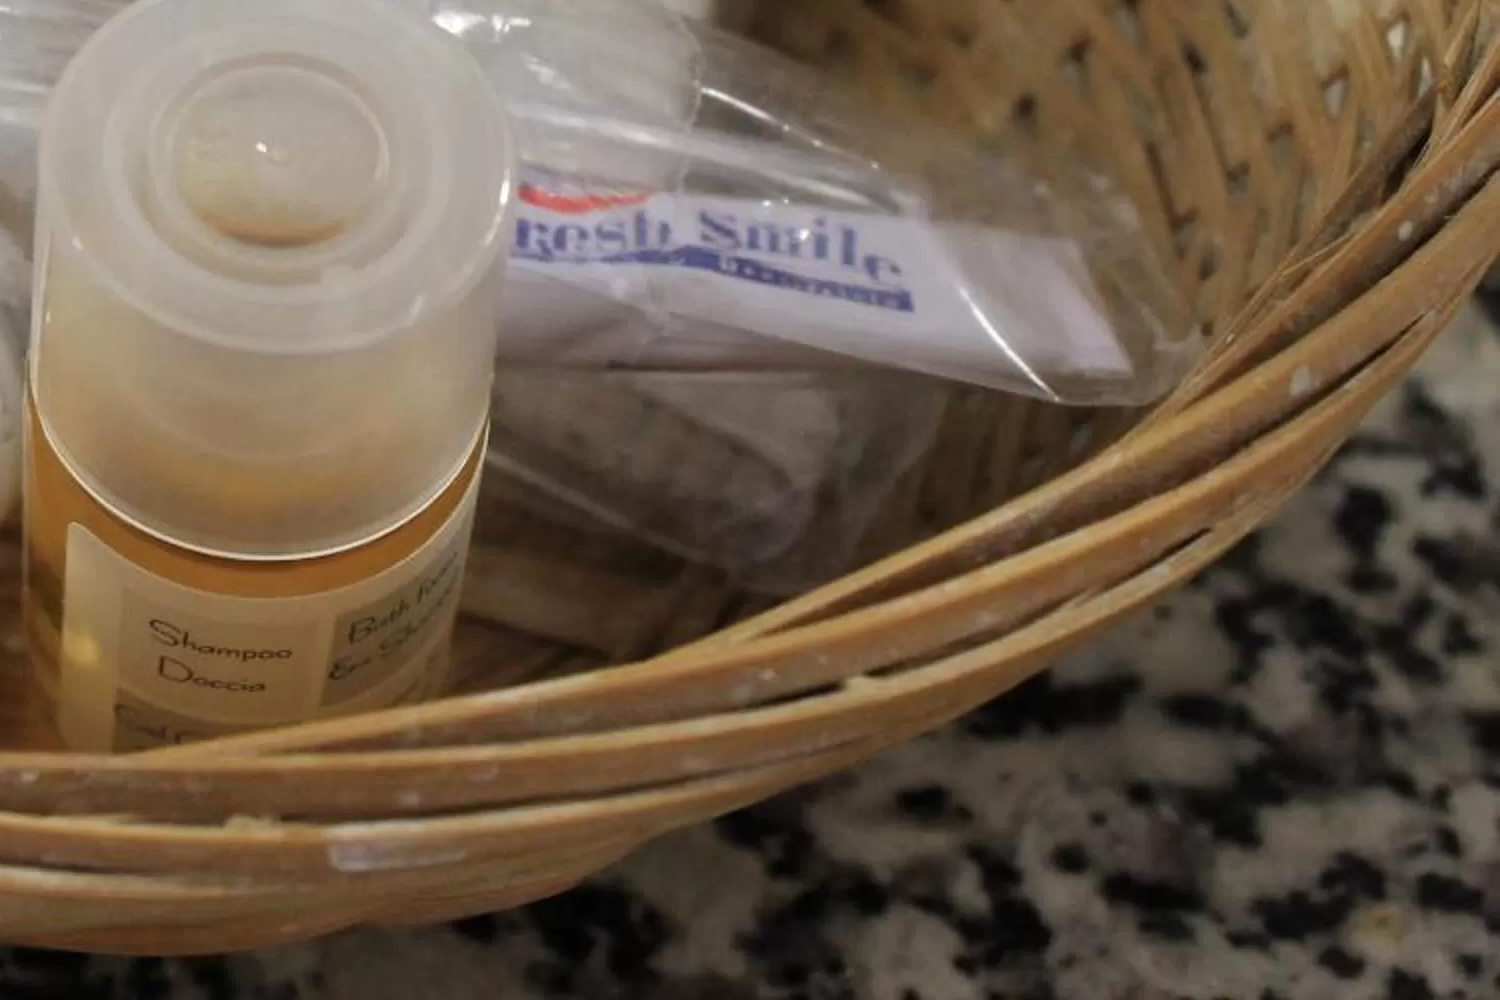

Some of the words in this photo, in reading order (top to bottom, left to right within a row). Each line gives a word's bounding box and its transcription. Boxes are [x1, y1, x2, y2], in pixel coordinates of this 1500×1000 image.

[514, 210, 672, 256] resh
[700, 208, 902, 282] Smile
[148, 618, 293, 662] Shampoo
[157, 655, 267, 693] Doccia
